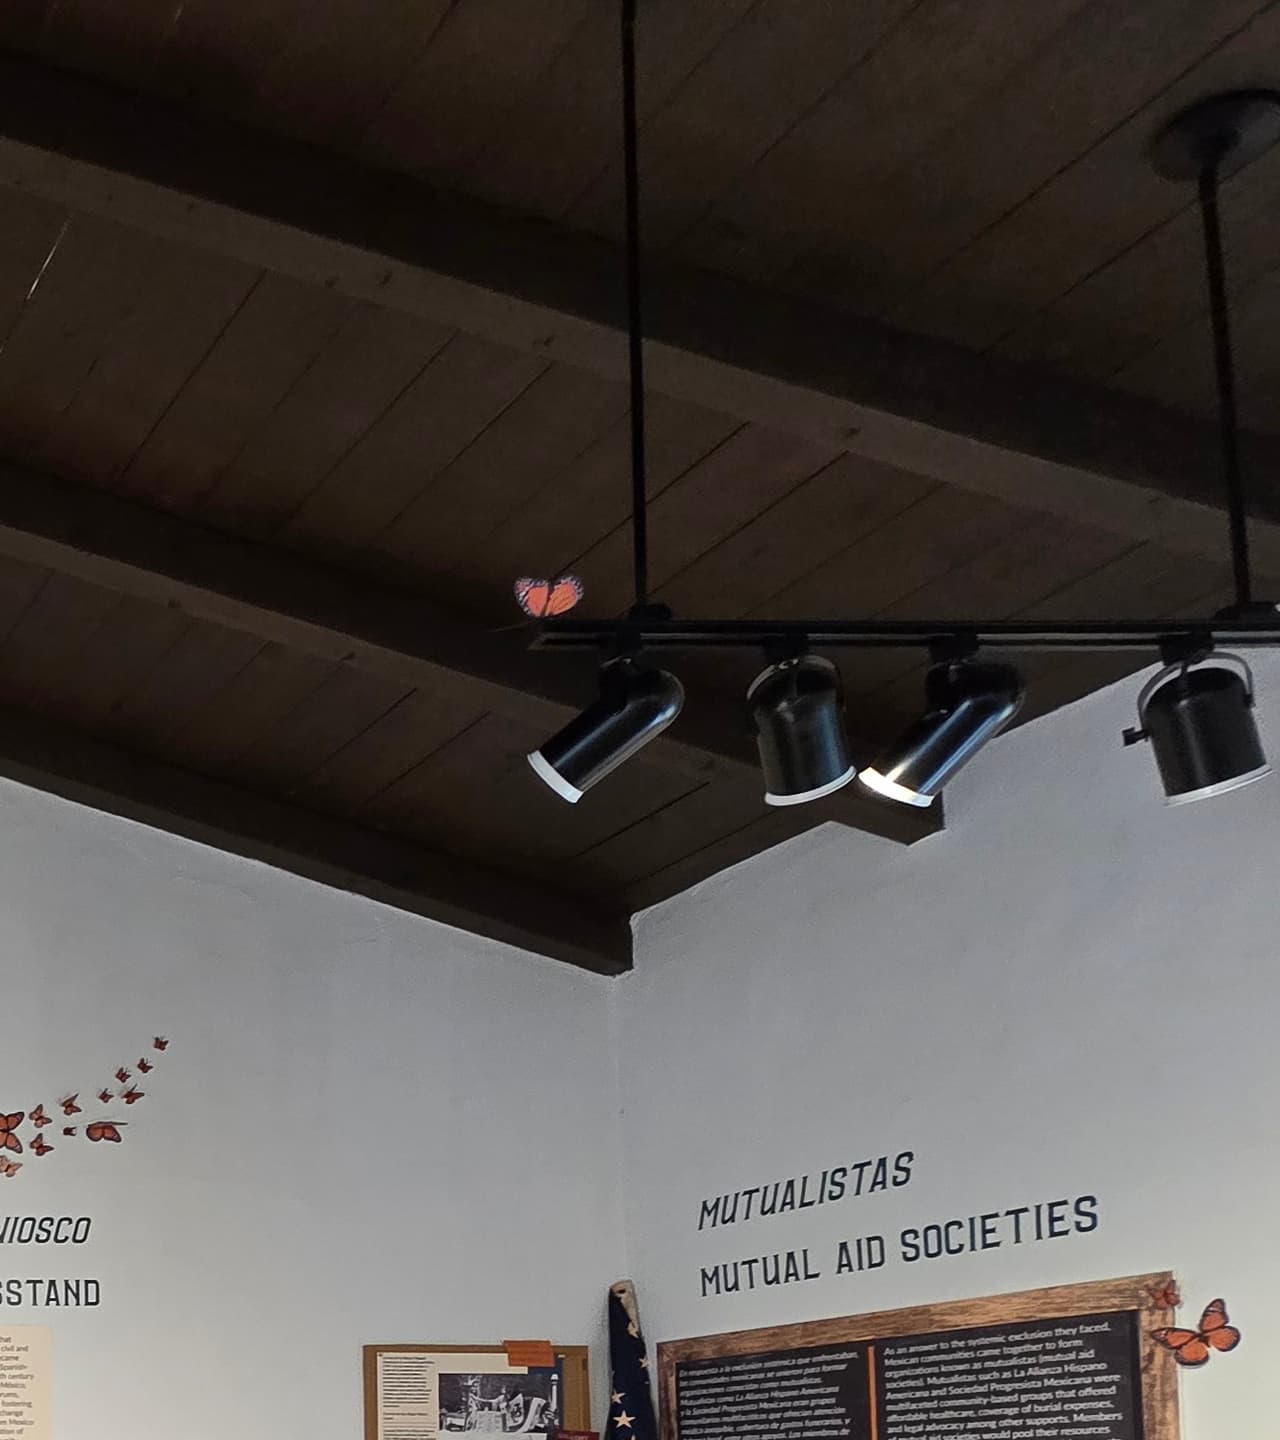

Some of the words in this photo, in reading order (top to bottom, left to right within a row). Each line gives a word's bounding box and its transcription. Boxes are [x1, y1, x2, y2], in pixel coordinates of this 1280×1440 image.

[698, 1151, 914, 1230] MUTUALISTAS
[701, 1249, 820, 1297] MUTUAL
[835, 1235, 885, 1275] AID
[901, 1195, 1098, 1262] SOCIETIES
